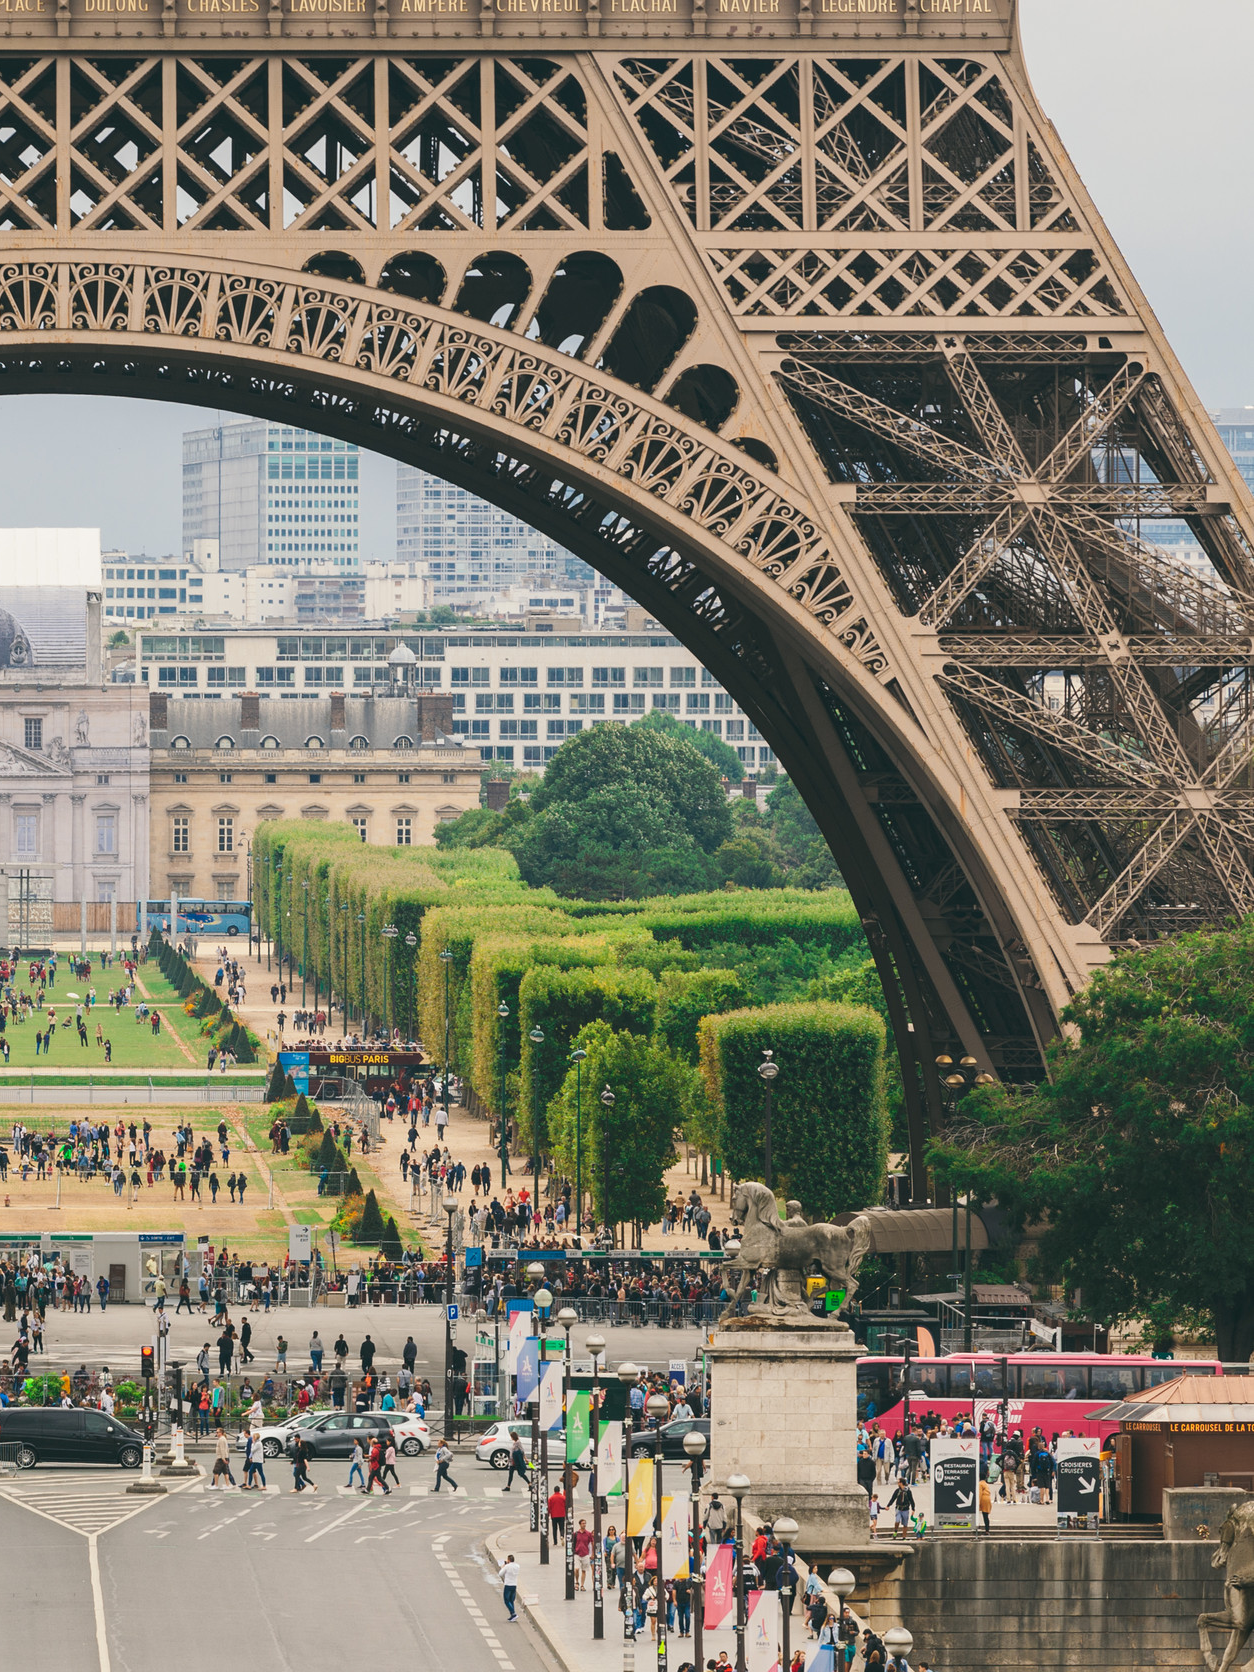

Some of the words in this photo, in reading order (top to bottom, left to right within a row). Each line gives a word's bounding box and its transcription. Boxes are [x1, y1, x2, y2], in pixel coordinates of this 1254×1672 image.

[85, 0, 149, 12] DULONG
[188, 0, 259, 12] CHASLES
[291, 0, 366, 12] LAVOISIER
[401, 0, 468, 12] AMPERE
[496, 0, 582, 12] CHEVREUL
[719, 0, 779, 13] NAVIER
[822, 0, 897, 13] LEGENDRE
[920, 0, 991, 13] CHAPTAL
[363, 1055, 389, 1063] PARIS
[450, 1307, 456, 1317] P
[1133, 1423, 1161, 1432] CARROUSEL
[1170, 1424, 1178, 1432] LE
[1181, 1424, 1222, 1432] CARROUSEL
[1225, 1424, 1233, 1432] DE
[1236, 1424, 1245, 1432] LA
